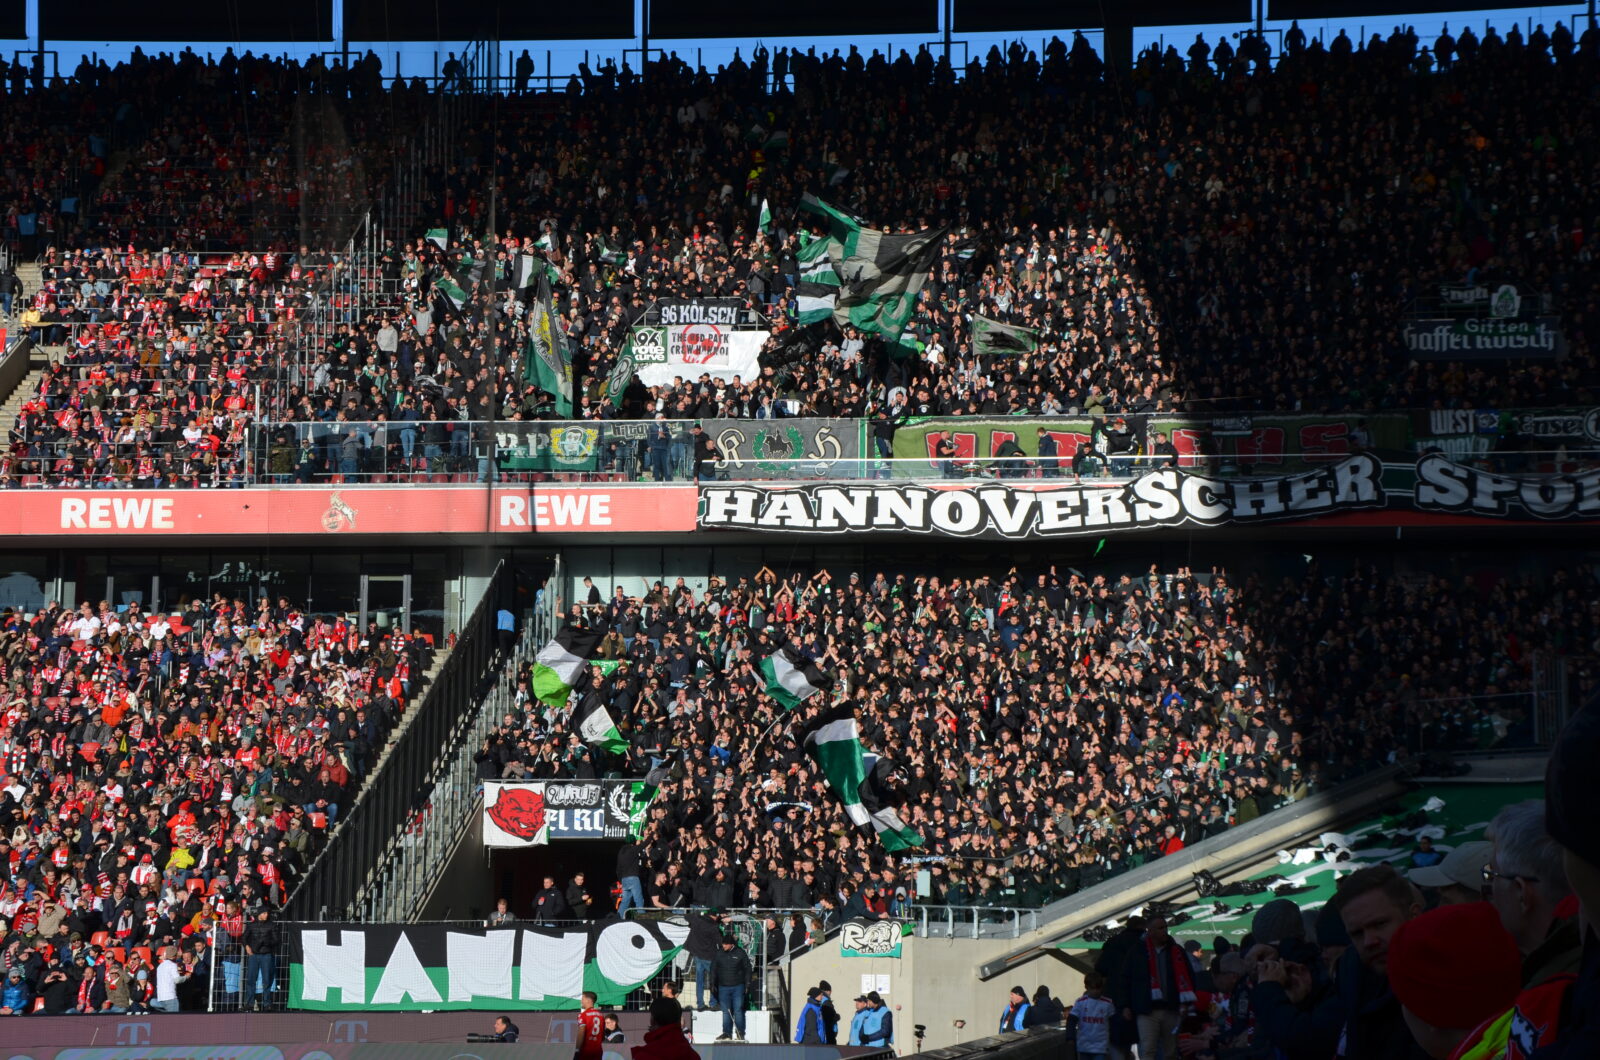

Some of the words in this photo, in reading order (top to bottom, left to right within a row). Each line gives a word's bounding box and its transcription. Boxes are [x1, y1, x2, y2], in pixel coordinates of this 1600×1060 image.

[661, 305, 677, 325] 96
[679, 300, 738, 325] KÖLSCH
[637, 332, 661, 347] 96
[672, 333, 687, 342] THE
[632, 344, 666, 356] rote
[1430, 409, 1475, 435] WEST
[61, 497, 175, 528] REWE
[500, 494, 612, 525] REWE
[704, 470, 1377, 535] HANNOVERSCHER
[591, 1017, 600, 1036] 8
[1082, 1016, 1105, 1025] REWE
